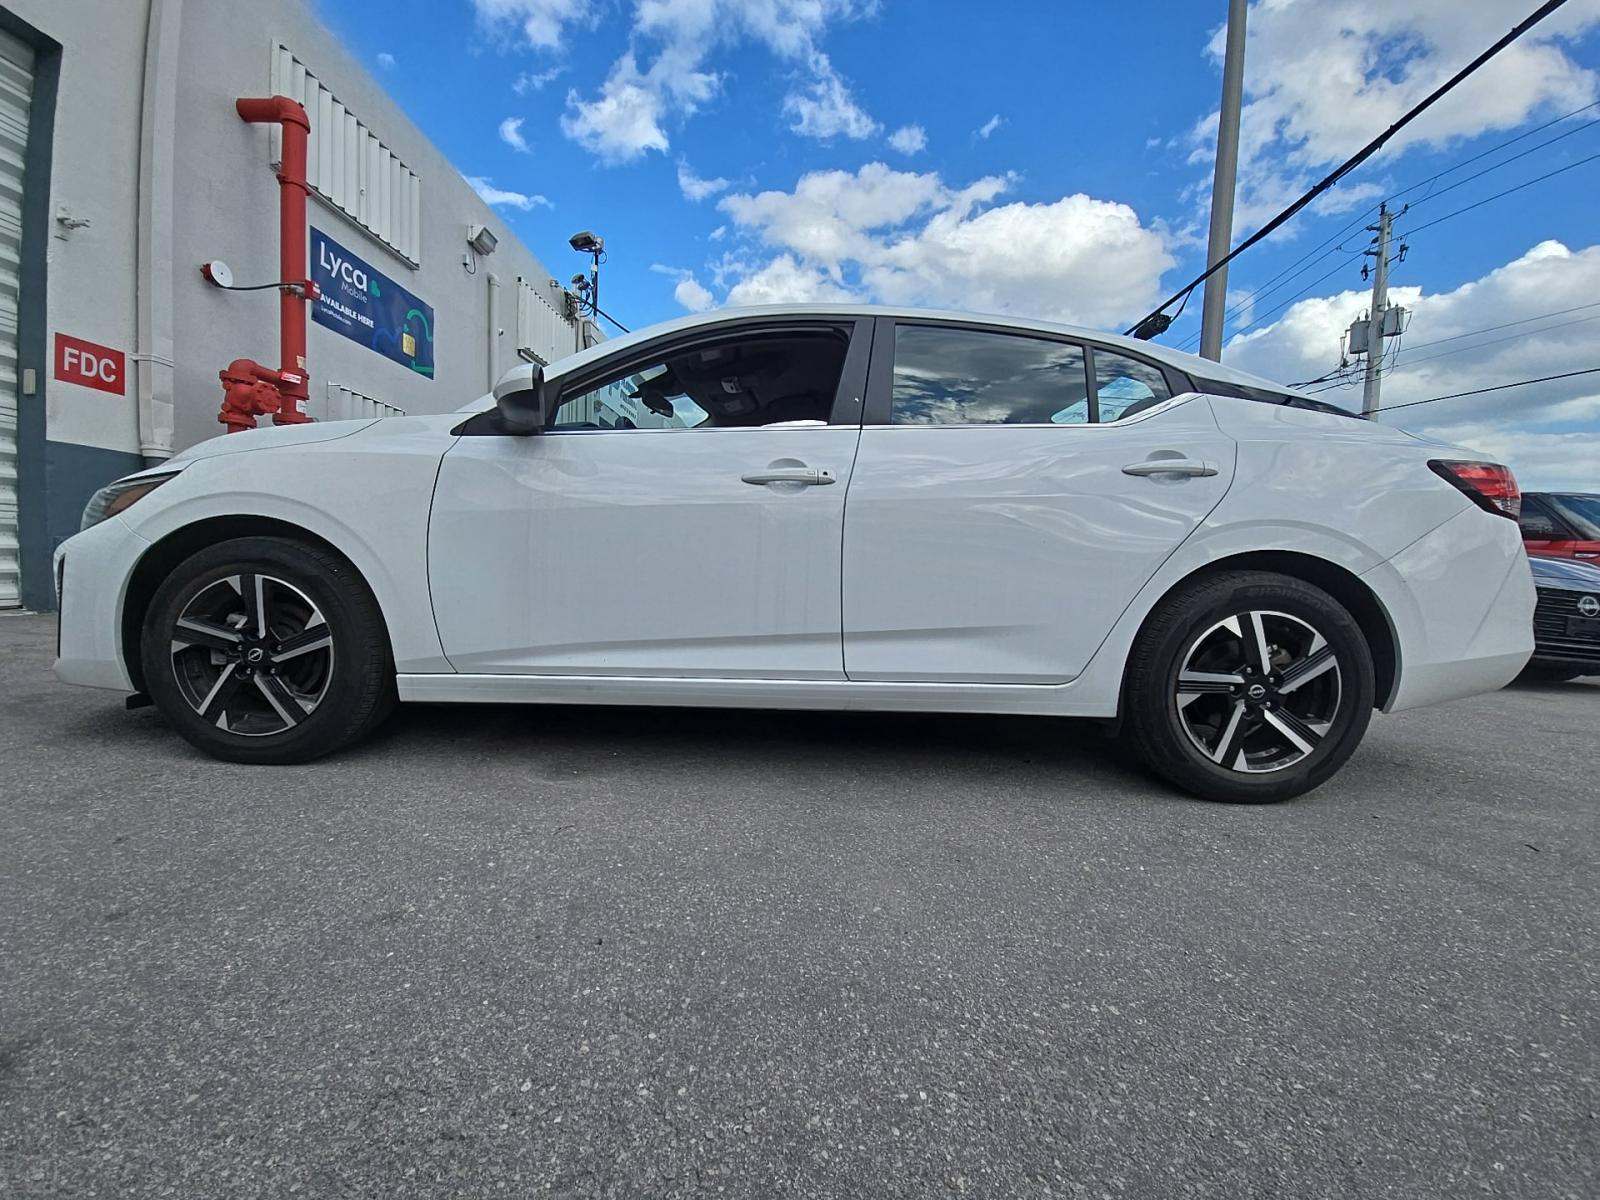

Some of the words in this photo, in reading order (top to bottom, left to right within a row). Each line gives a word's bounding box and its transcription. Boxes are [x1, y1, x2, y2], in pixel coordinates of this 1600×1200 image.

[320, 241, 367, 292] Lyca
[341, 281, 368, 303] Mobile
[320, 293, 357, 320] AVAILABLE
[357, 313, 375, 329] HERE
[63, 346, 117, 383] FDC
